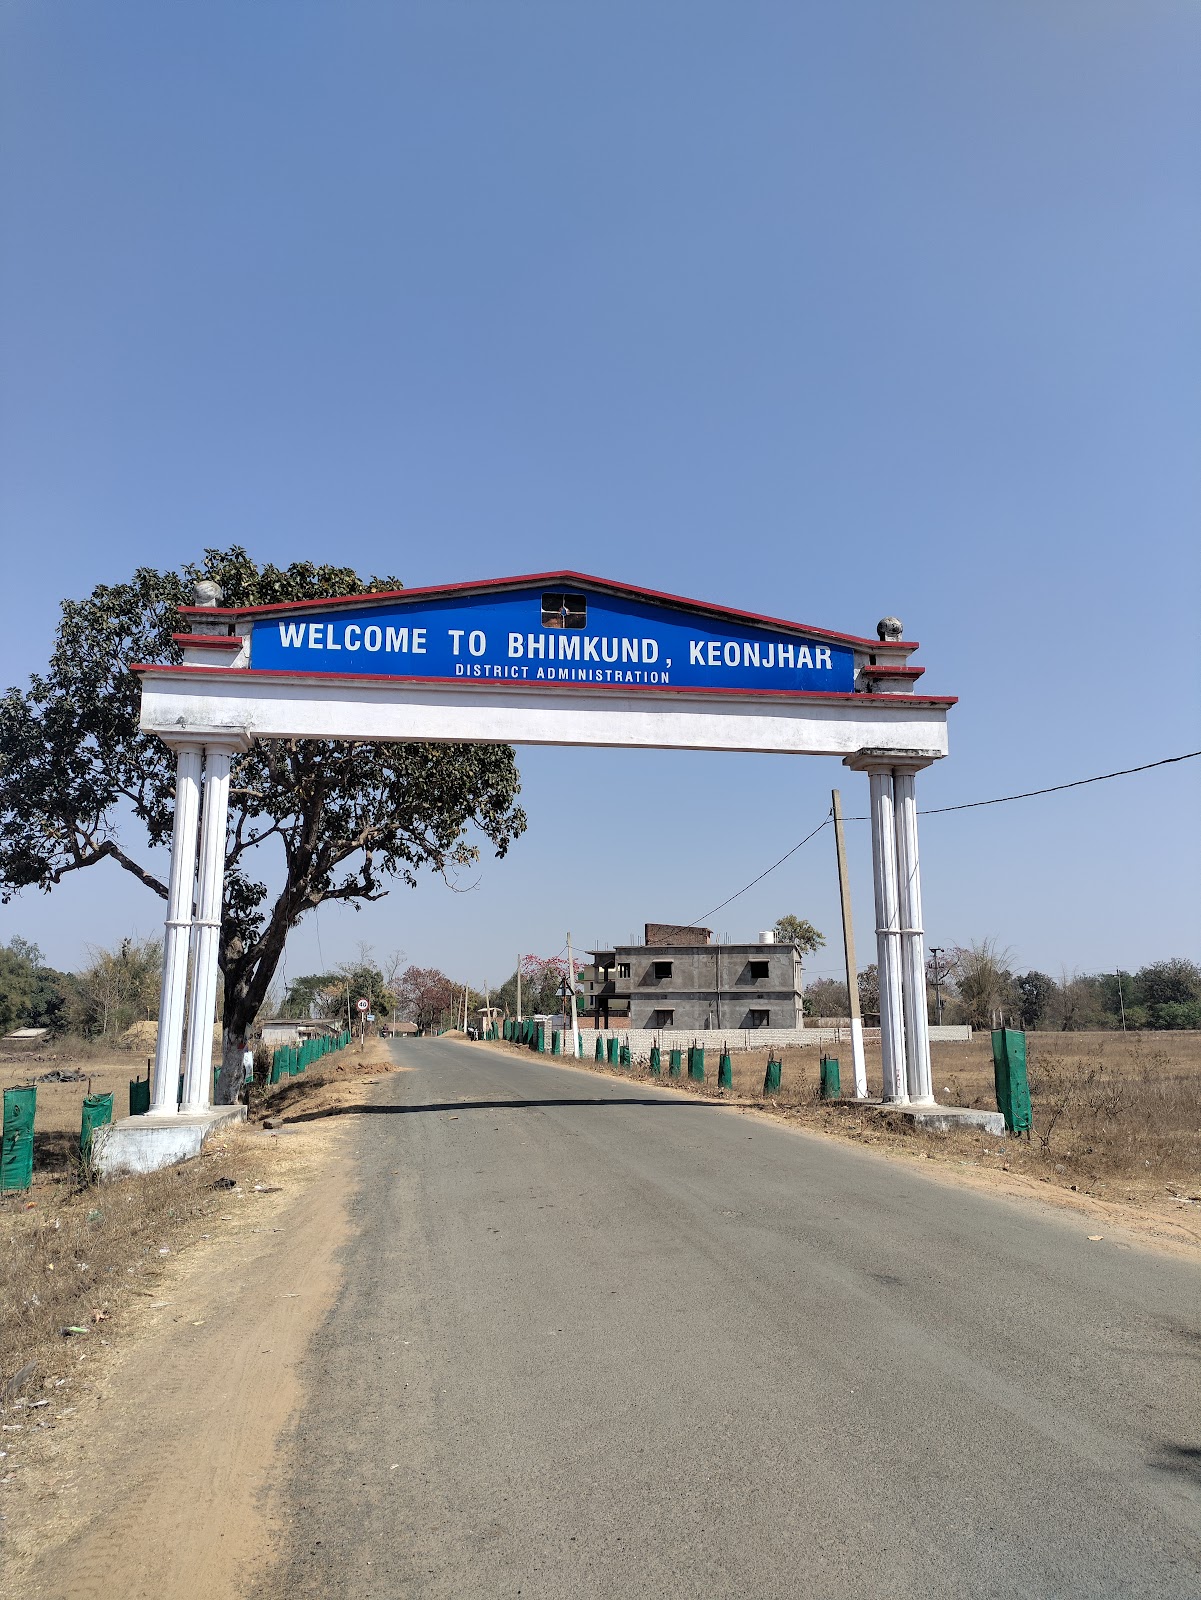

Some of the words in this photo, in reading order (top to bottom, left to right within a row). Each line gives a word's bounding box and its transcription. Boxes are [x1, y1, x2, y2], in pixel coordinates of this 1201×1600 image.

[279, 623, 427, 654] WELCOME
[449, 630, 486, 656] TO
[689, 641, 832, 669] KEONJHAR
[456, 664, 529, 679] DISTRICT
[537, 668, 669, 684] ADMINISTRATION
